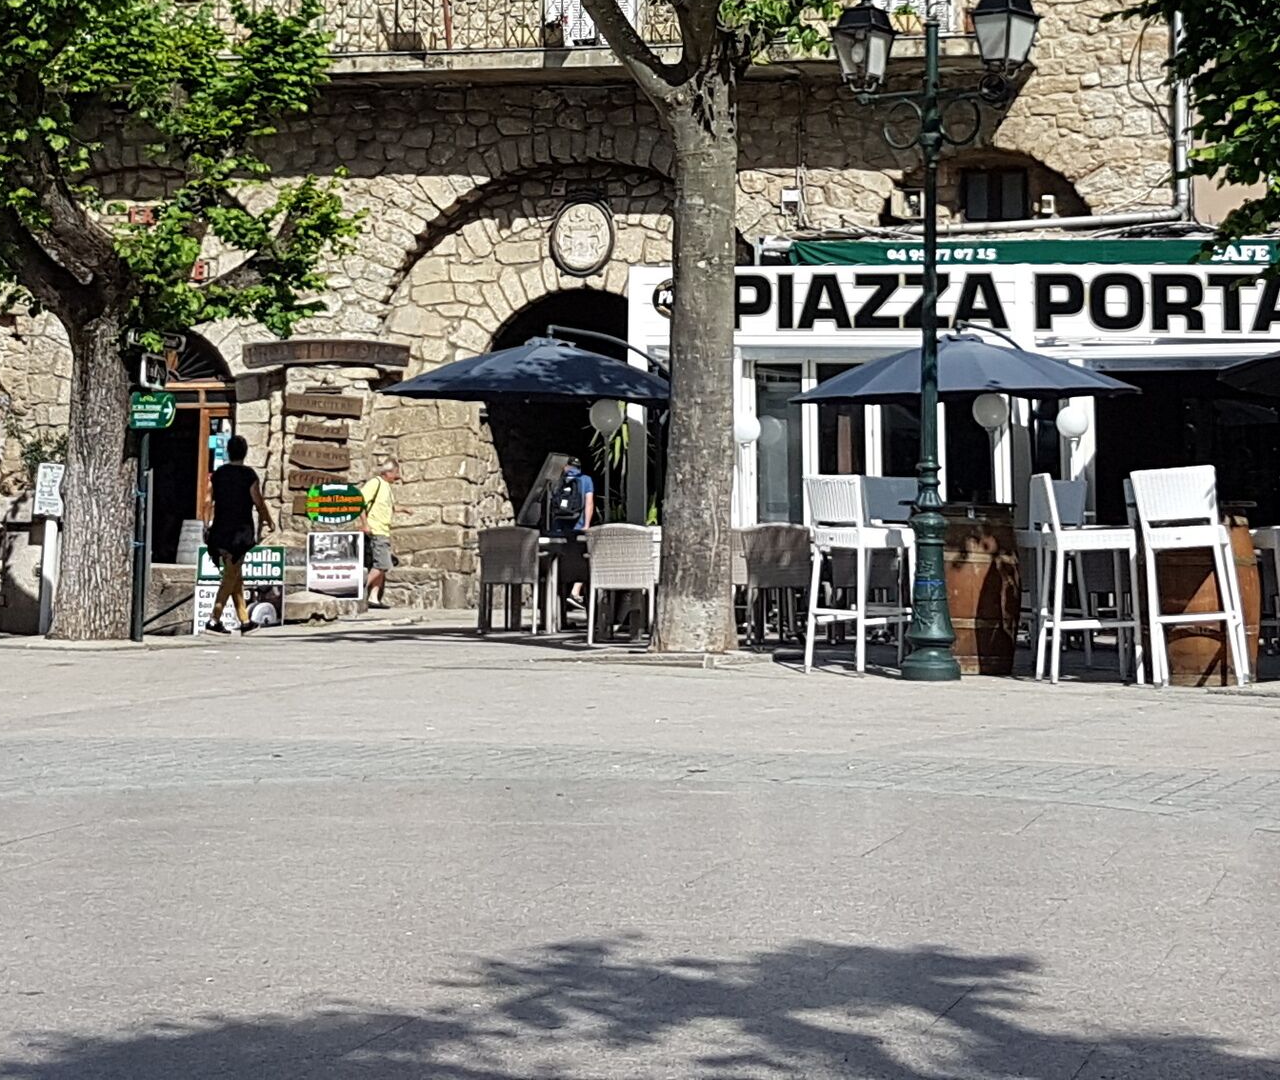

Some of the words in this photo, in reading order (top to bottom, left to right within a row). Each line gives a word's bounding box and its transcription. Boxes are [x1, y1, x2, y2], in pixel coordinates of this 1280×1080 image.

[886, 249, 907, 261] 04
[953, 249, 974, 261] 07
[976, 248, 997, 260] 15
[734, 272, 1011, 332] PIAZZA
[244, 549, 281, 562] oulin
[241, 563, 281, 577] Huile
